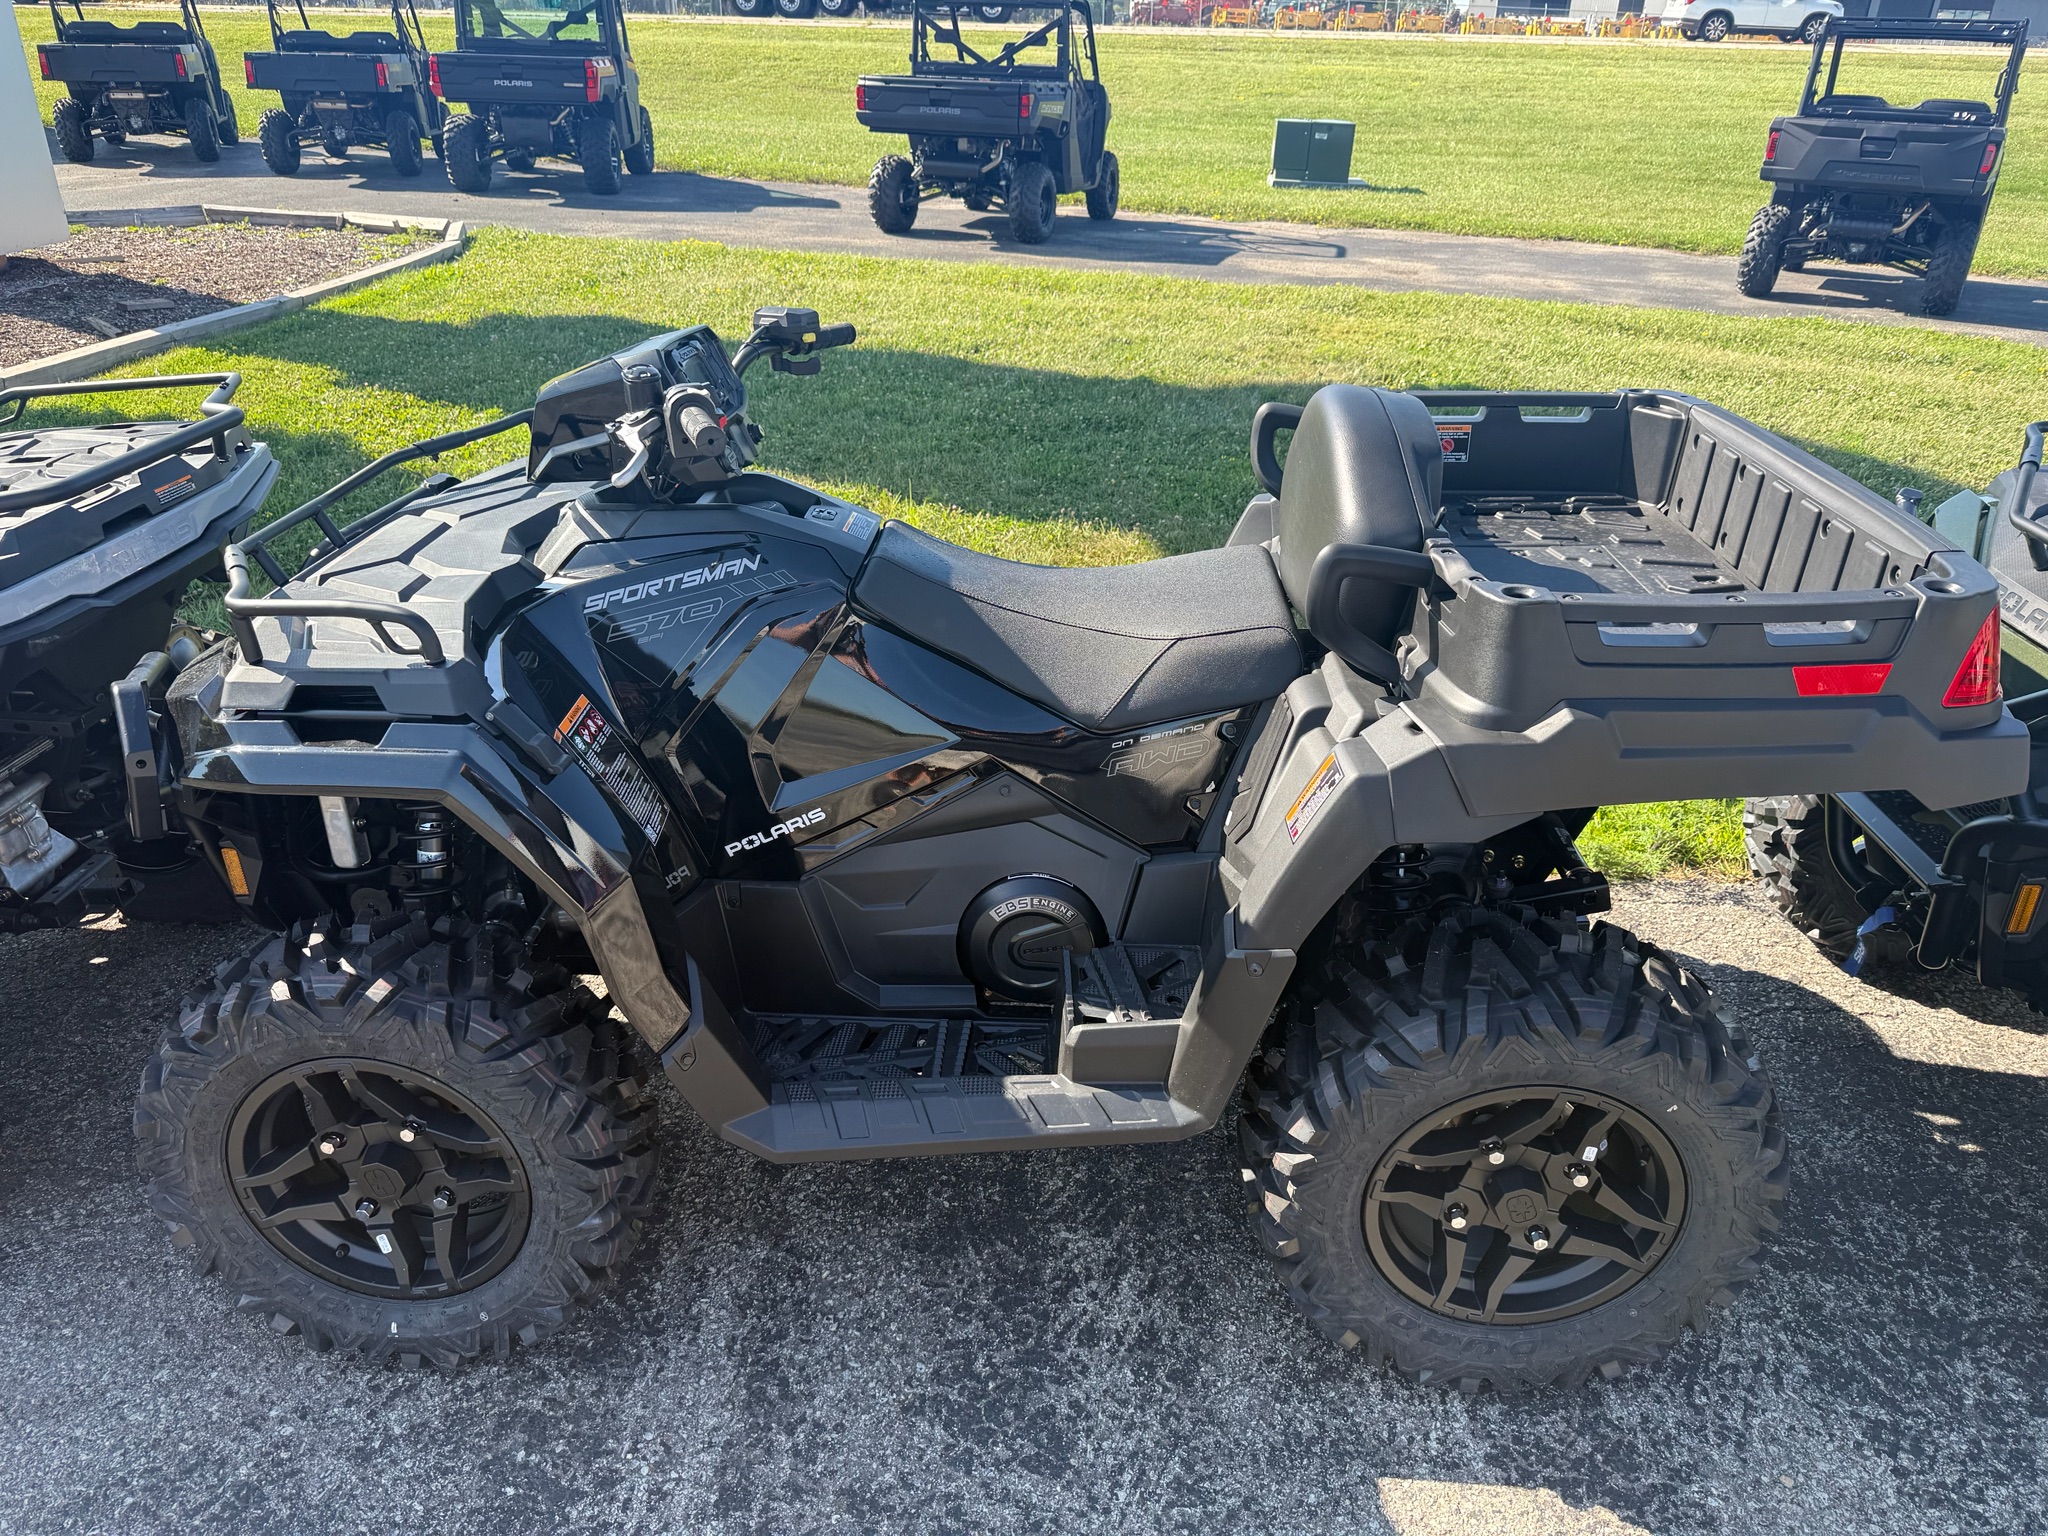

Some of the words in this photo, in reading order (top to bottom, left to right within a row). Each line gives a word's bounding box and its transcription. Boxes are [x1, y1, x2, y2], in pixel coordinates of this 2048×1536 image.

[493, 79, 533, 87] POLARIS
[919, 106, 961, 115] POLARIS
[583, 553, 761, 614] SPORTSMAN
[606, 597, 723, 643] 570
[1111, 738, 1134, 749] ON
[1139, 723, 1205, 742] DEMAND
[1106, 739, 1211, 778] AWD
[724, 807, 826, 858] POLARIS
[994, 898, 1029, 919] EBS
[1032, 898, 1075, 918] ENGINE
